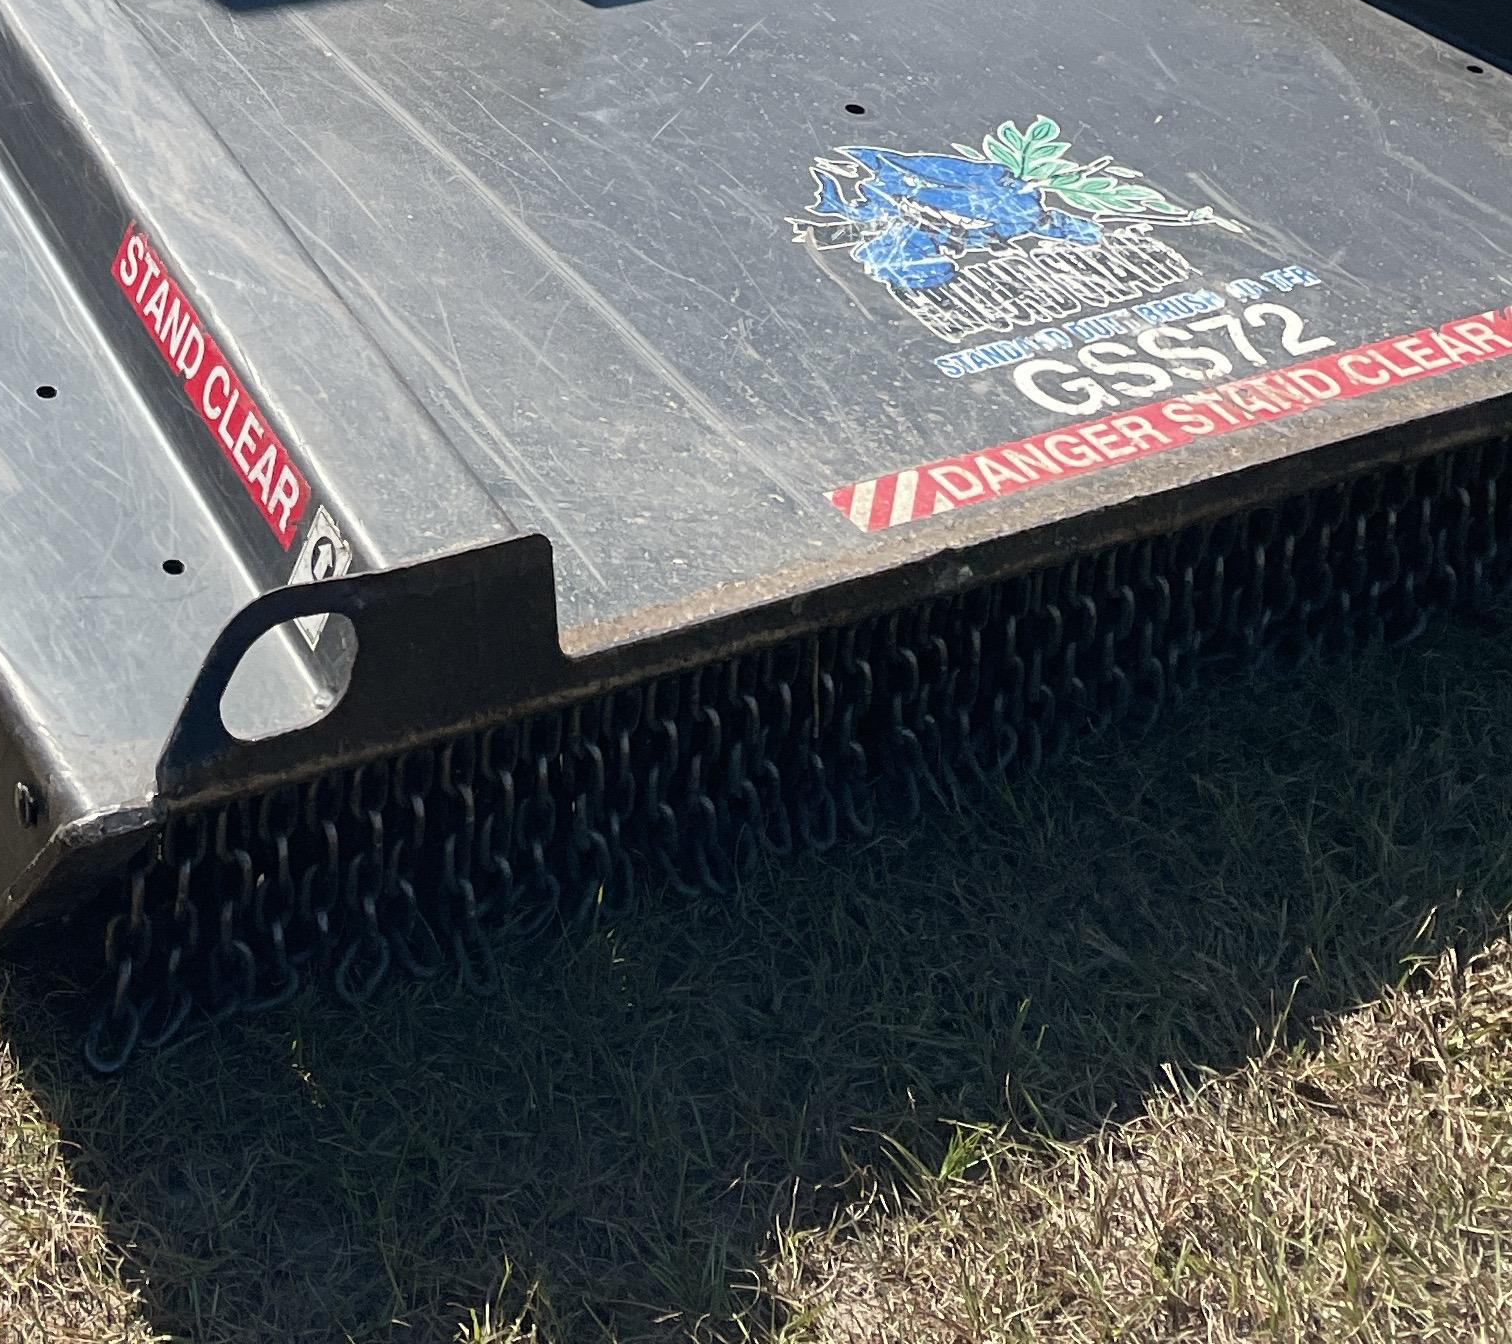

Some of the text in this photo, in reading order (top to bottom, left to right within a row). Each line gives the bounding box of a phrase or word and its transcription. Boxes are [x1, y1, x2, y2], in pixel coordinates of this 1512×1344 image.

[119, 233, 301, 534] STAND CLEAR
[928, 320, 1511, 501] DANGER STAND CLEAR
[1013, 302, 1337, 416] GSS72
